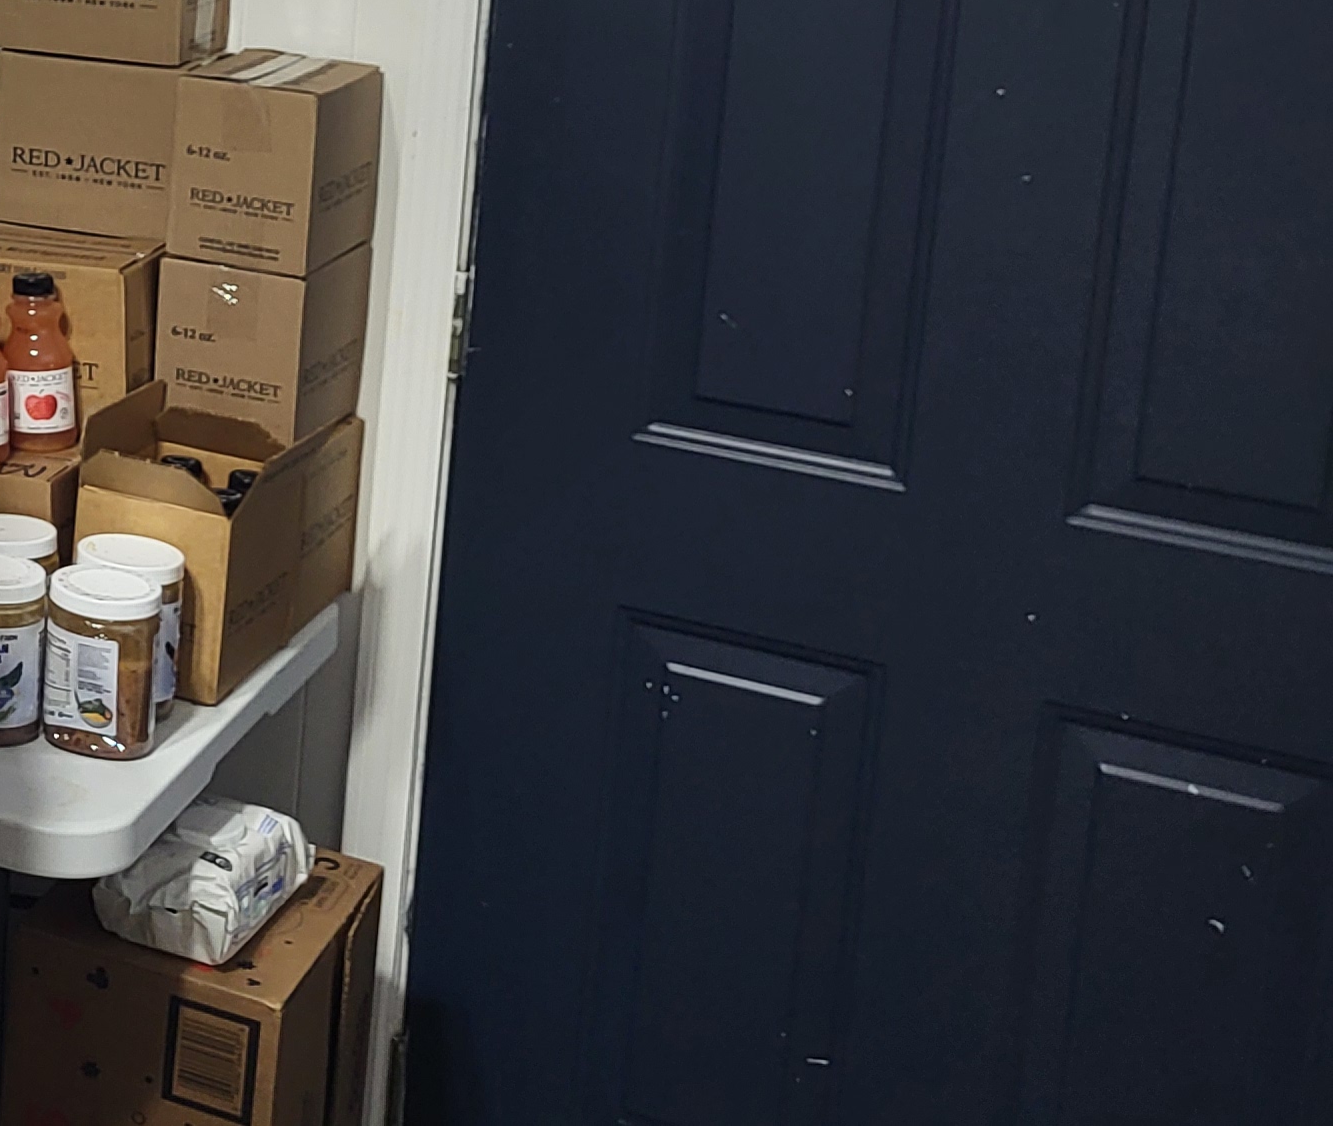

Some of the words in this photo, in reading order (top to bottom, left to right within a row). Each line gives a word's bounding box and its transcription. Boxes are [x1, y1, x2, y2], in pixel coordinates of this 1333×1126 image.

[11, 146, 61, 168] RED
[73, 154, 167, 182] JACKET
[186, 144, 211, 159] 6-12
[213, 149, 231, 162] oz.
[189, 187, 225, 202] RED
[233, 194, 295, 217] JACKET
[170, 325, 197, 340] 6-12
[198, 331, 217, 343] oz.
[175, 367, 211, 385] RED
[217, 375, 283, 398] JACKET
